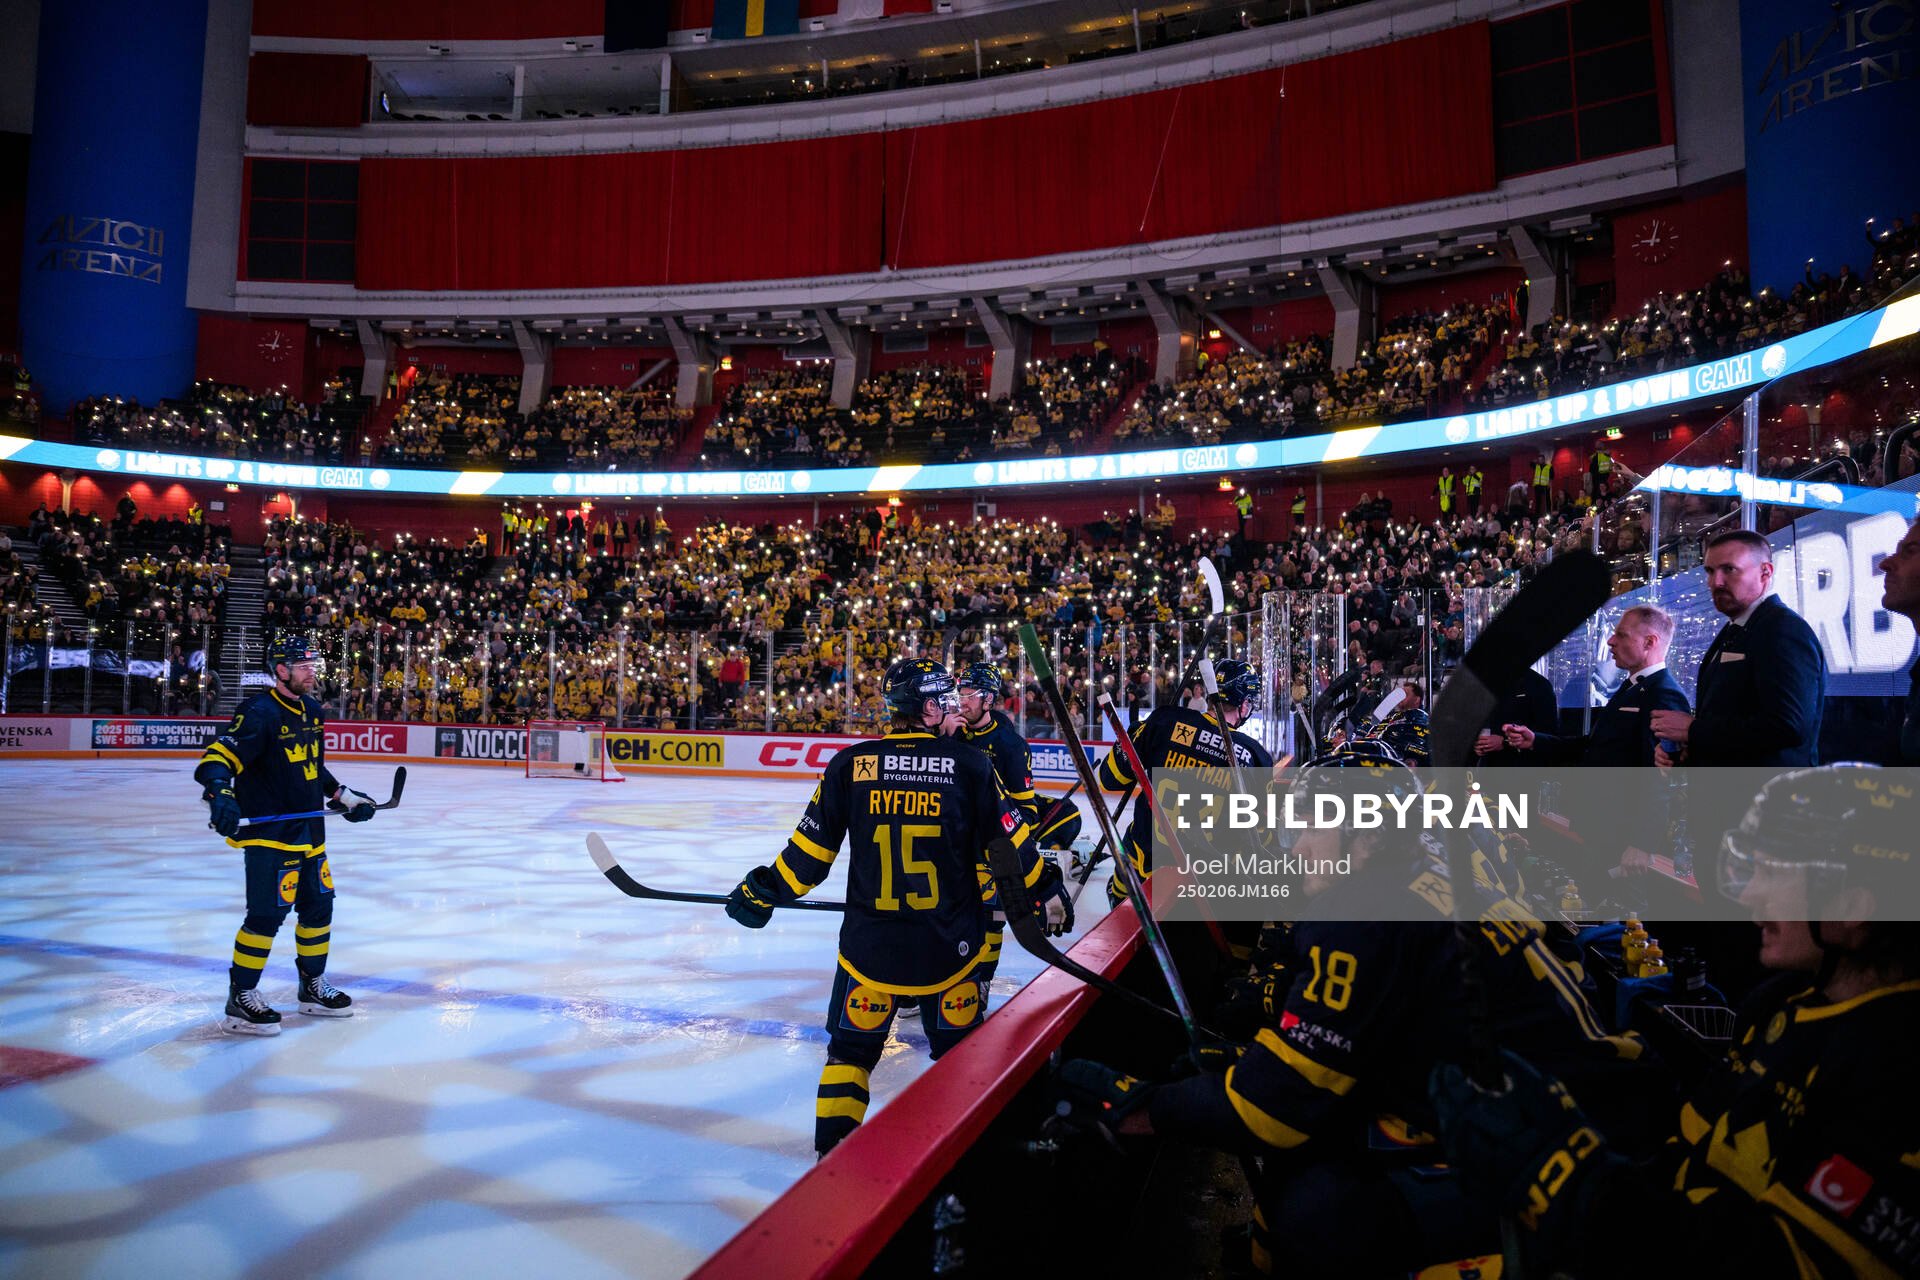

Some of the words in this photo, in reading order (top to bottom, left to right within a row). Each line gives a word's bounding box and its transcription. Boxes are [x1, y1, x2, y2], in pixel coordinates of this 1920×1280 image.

[36, 213, 164, 257] AVICII
[37, 248, 162, 284] ARENA
[1475, 402, 1552, 438] LIGHTS
[1557, 394, 1587, 422] UP
[1593, 389, 1611, 415] &
[1616, 371, 1690, 411] DOWN
[1695, 355, 1752, 393] CAM
[126, 452, 201, 476] LIGHTS
[206, 458, 235, 480] UP
[238, 461, 254, 482] &
[258, 465, 317, 486] DOWN
[320, 467, 363, 488] CAM
[998, 459, 1066, 484] LIGHTS
[1070, 456, 1097, 479] UP
[1120, 450, 1178, 476] DOWN
[1182, 446, 1228, 470] CAM
[575, 474, 639, 493] LIGHTS
[642, 474, 668, 494] UP
[744, 472, 785, 492] CAM
[95, 725, 122, 734] 2025
[124, 725, 146, 735] IIHF
[147, 725, 216, 735] ISHOCKEY-VM
[95, 735, 118, 744] SWE
[124, 736, 146, 745] DEN
[181, 736, 203, 745] MAJ
[1198, 730, 1252, 764] BEIER
[883, 755, 955, 775] BEIJER
[883, 774, 954, 785] BYGGMATERIAL
[869, 790, 941, 817] RYFORS
[873, 824, 942, 911] 15
[1303, 945, 1358, 1012] 18
